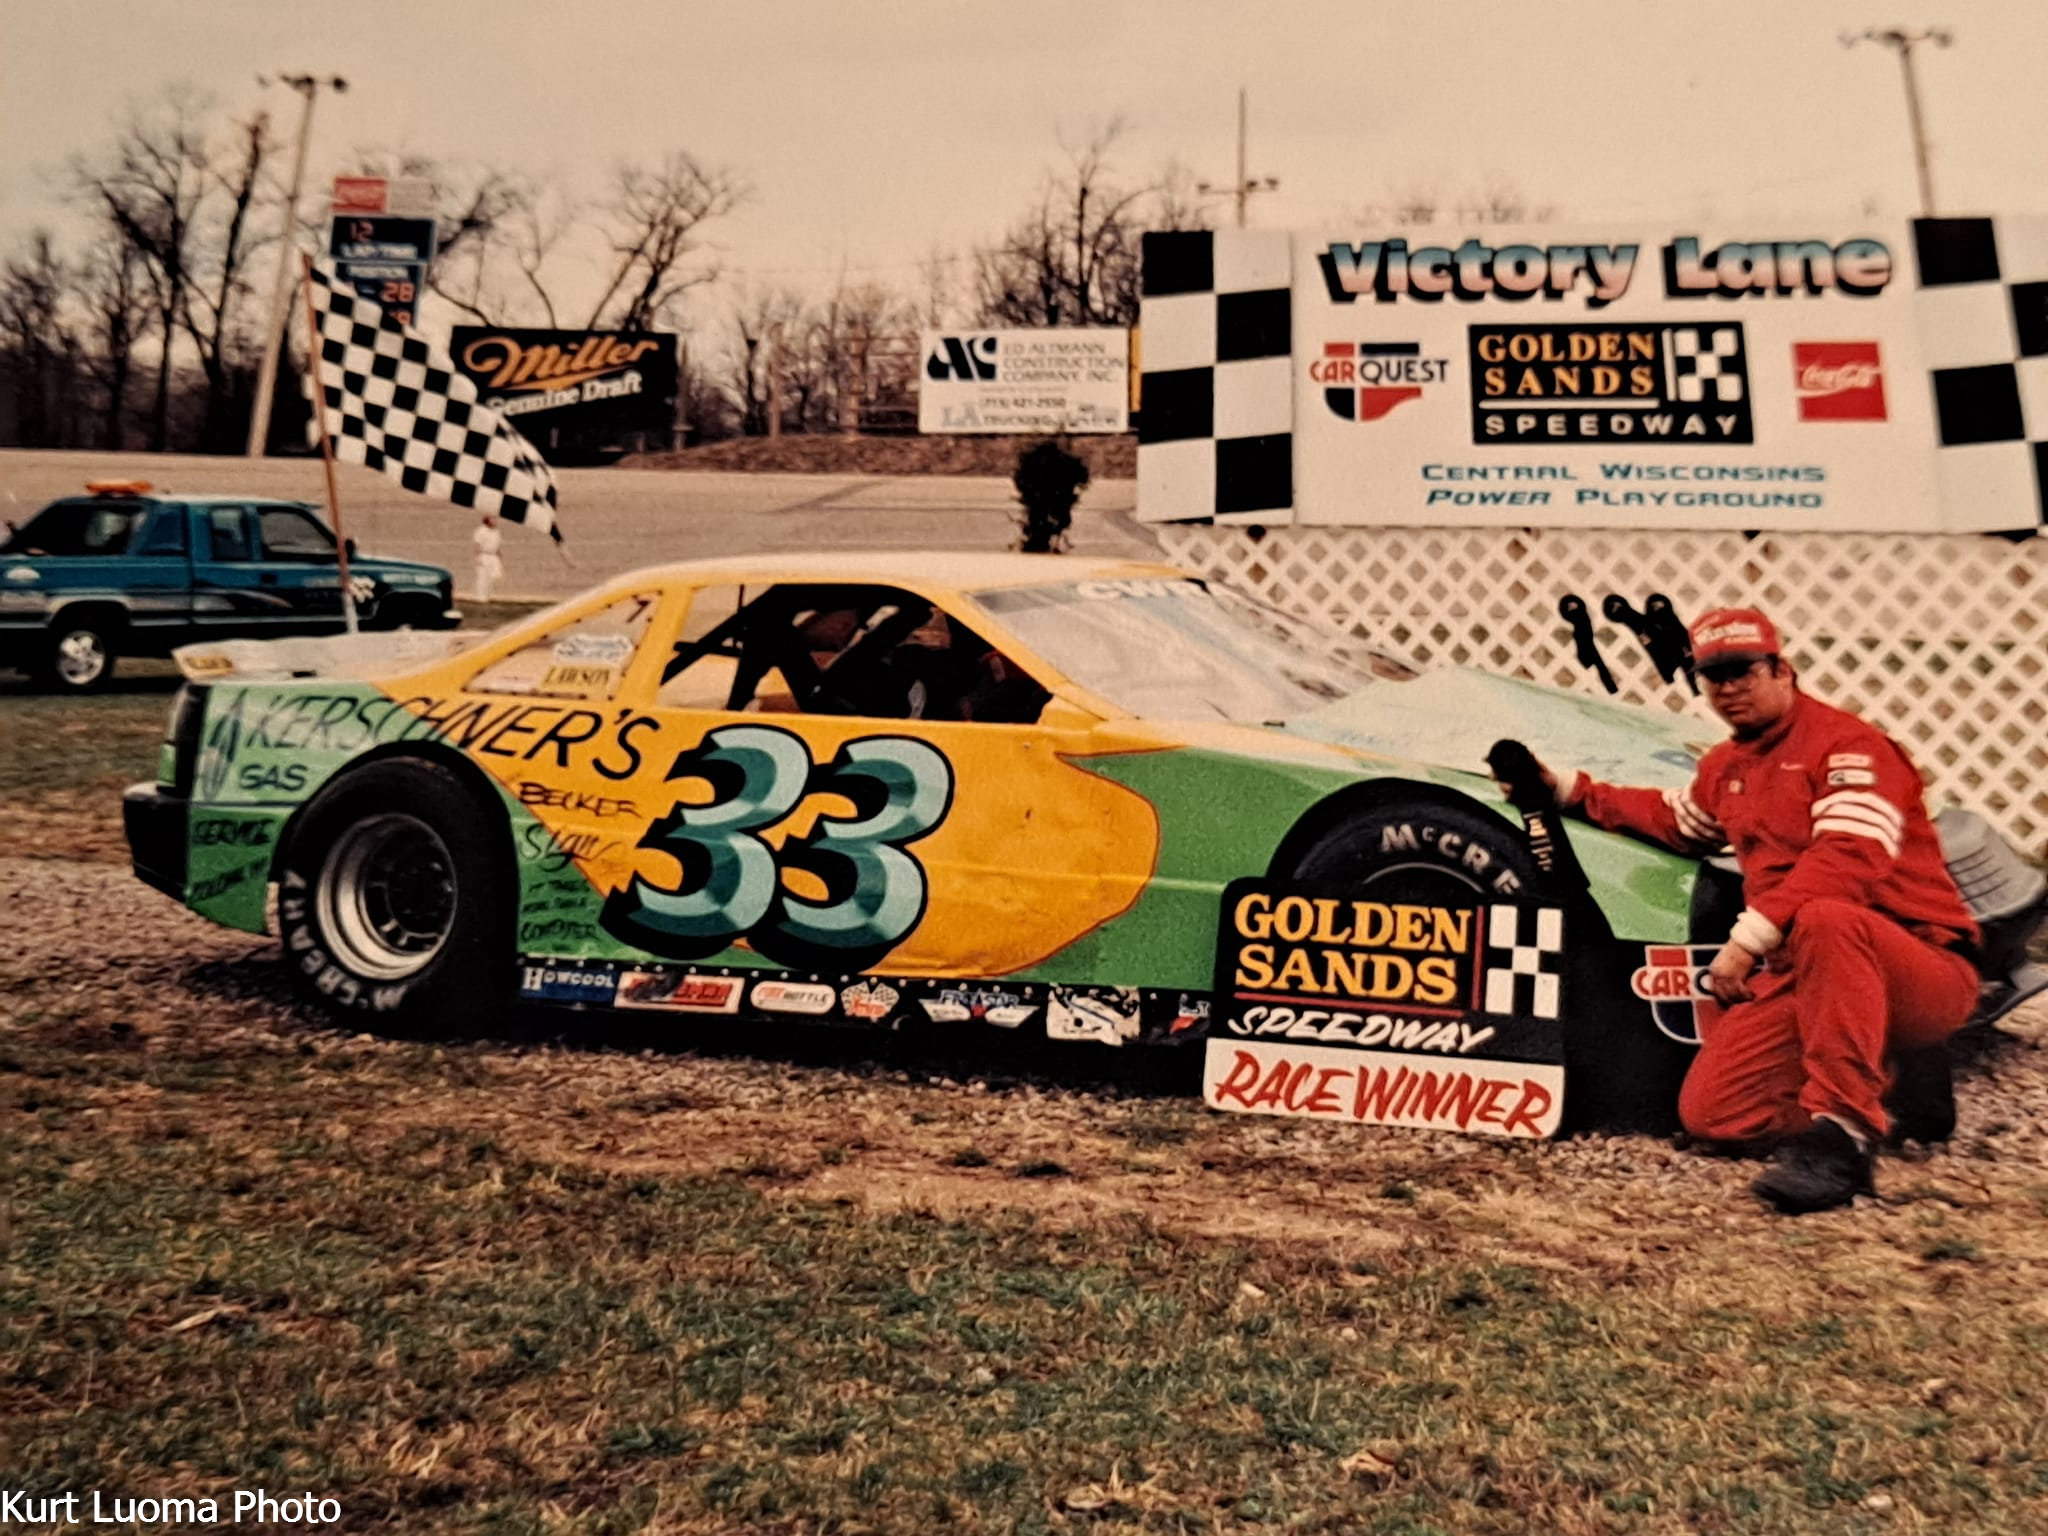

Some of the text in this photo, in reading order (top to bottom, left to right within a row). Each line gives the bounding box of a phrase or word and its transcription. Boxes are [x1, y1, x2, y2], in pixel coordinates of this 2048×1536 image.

[1318, 237, 1892, 310] Victory Lane
[463, 336, 660, 388] Miller
[1478, 332, 1655, 362] GOLDEN
[582, 370, 643, 402] Draft
[1309, 359, 1448, 385] CARQUEST
[1485, 366, 1655, 396] SANDS
[1485, 413, 1737, 436] SPEEDWAY
[1421, 463, 1826, 482] CENTRAL WISCONSINS
[1426, 489, 1823, 508] POWER PLAYGROUND
[246, 694, 660, 780] KERSCHNER'S
[239, 764, 308, 791] GAS
[519, 782, 643, 818] BECKER
[599, 722, 956, 973] 33
[1233, 892, 1473, 954] GOLDEN
[1234, 944, 1459, 1004] SANDS
[1227, 1006, 1497, 1053] SPEEDWAY
[1214, 1049, 1553, 1137] RACE WINNER
